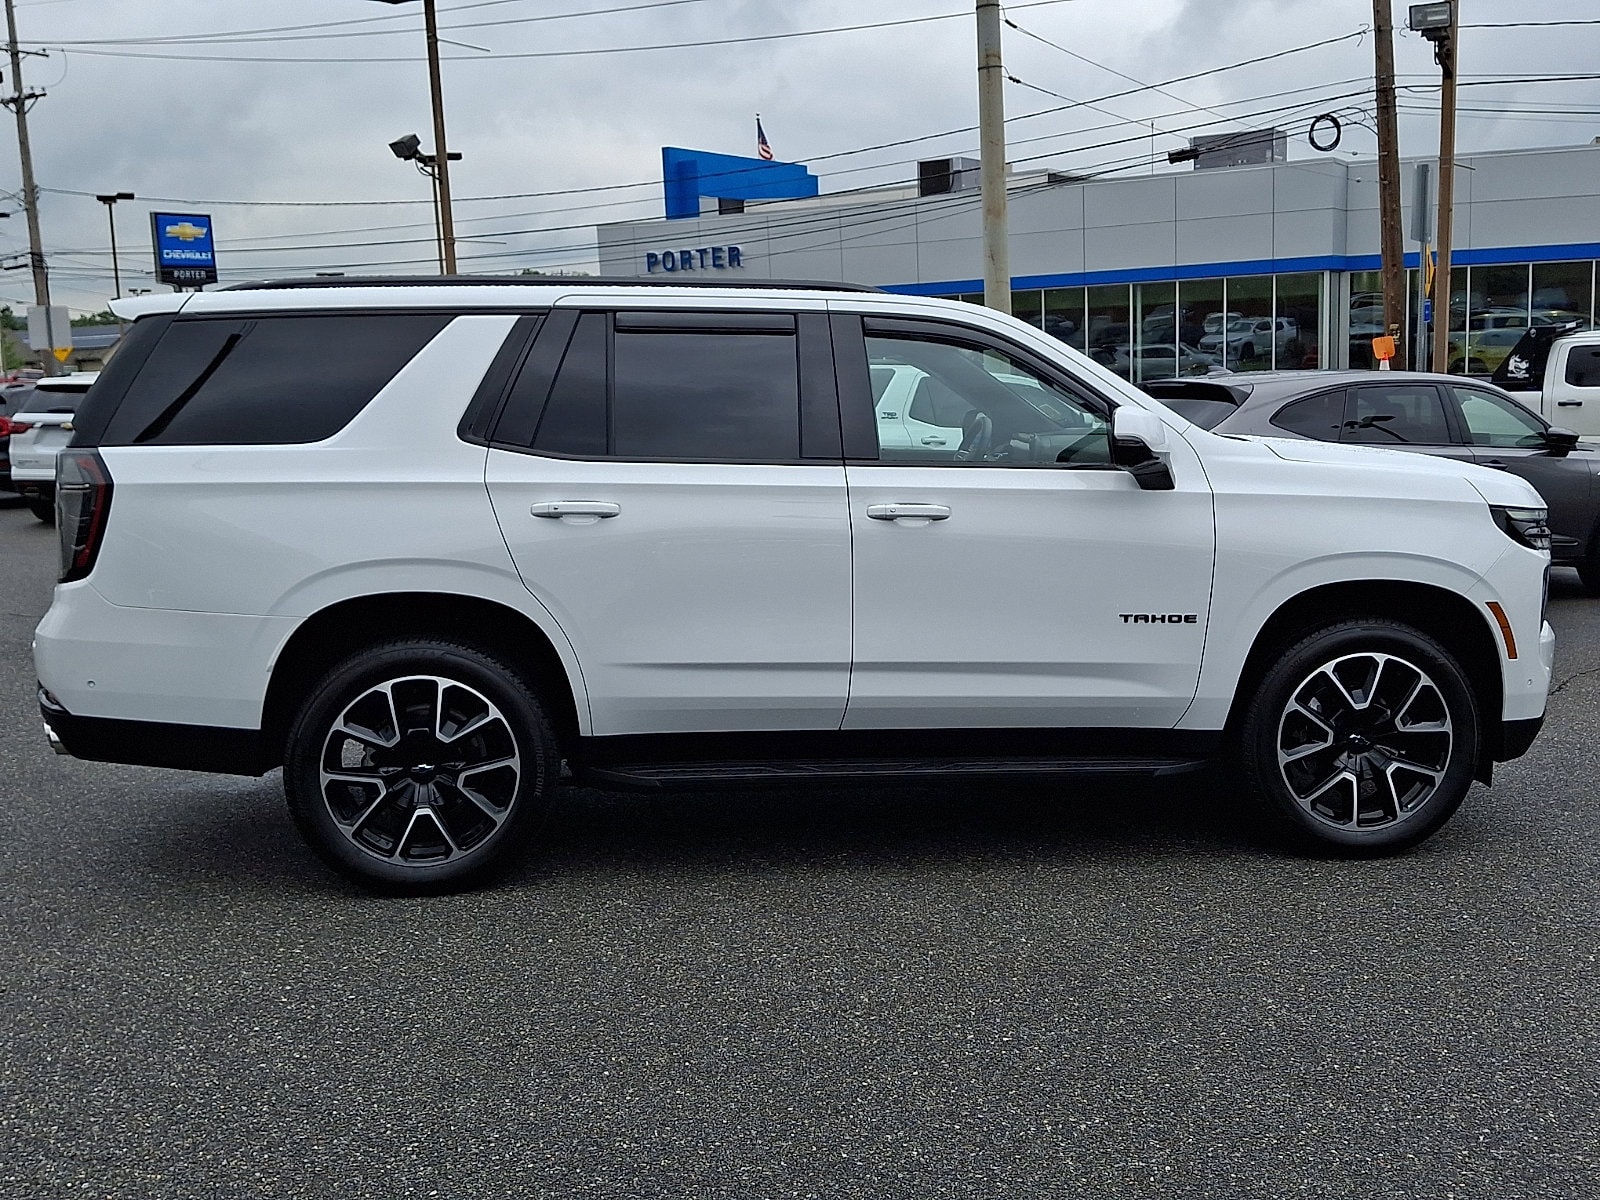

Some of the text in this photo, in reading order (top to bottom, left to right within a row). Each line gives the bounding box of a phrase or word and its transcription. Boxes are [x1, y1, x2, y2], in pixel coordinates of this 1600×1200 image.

[163, 249, 212, 260] CHEVROLET
[646, 246, 741, 273] PORTER
[173, 270, 207, 280] PORTER
[1118, 613, 1198, 624] TAHOE
